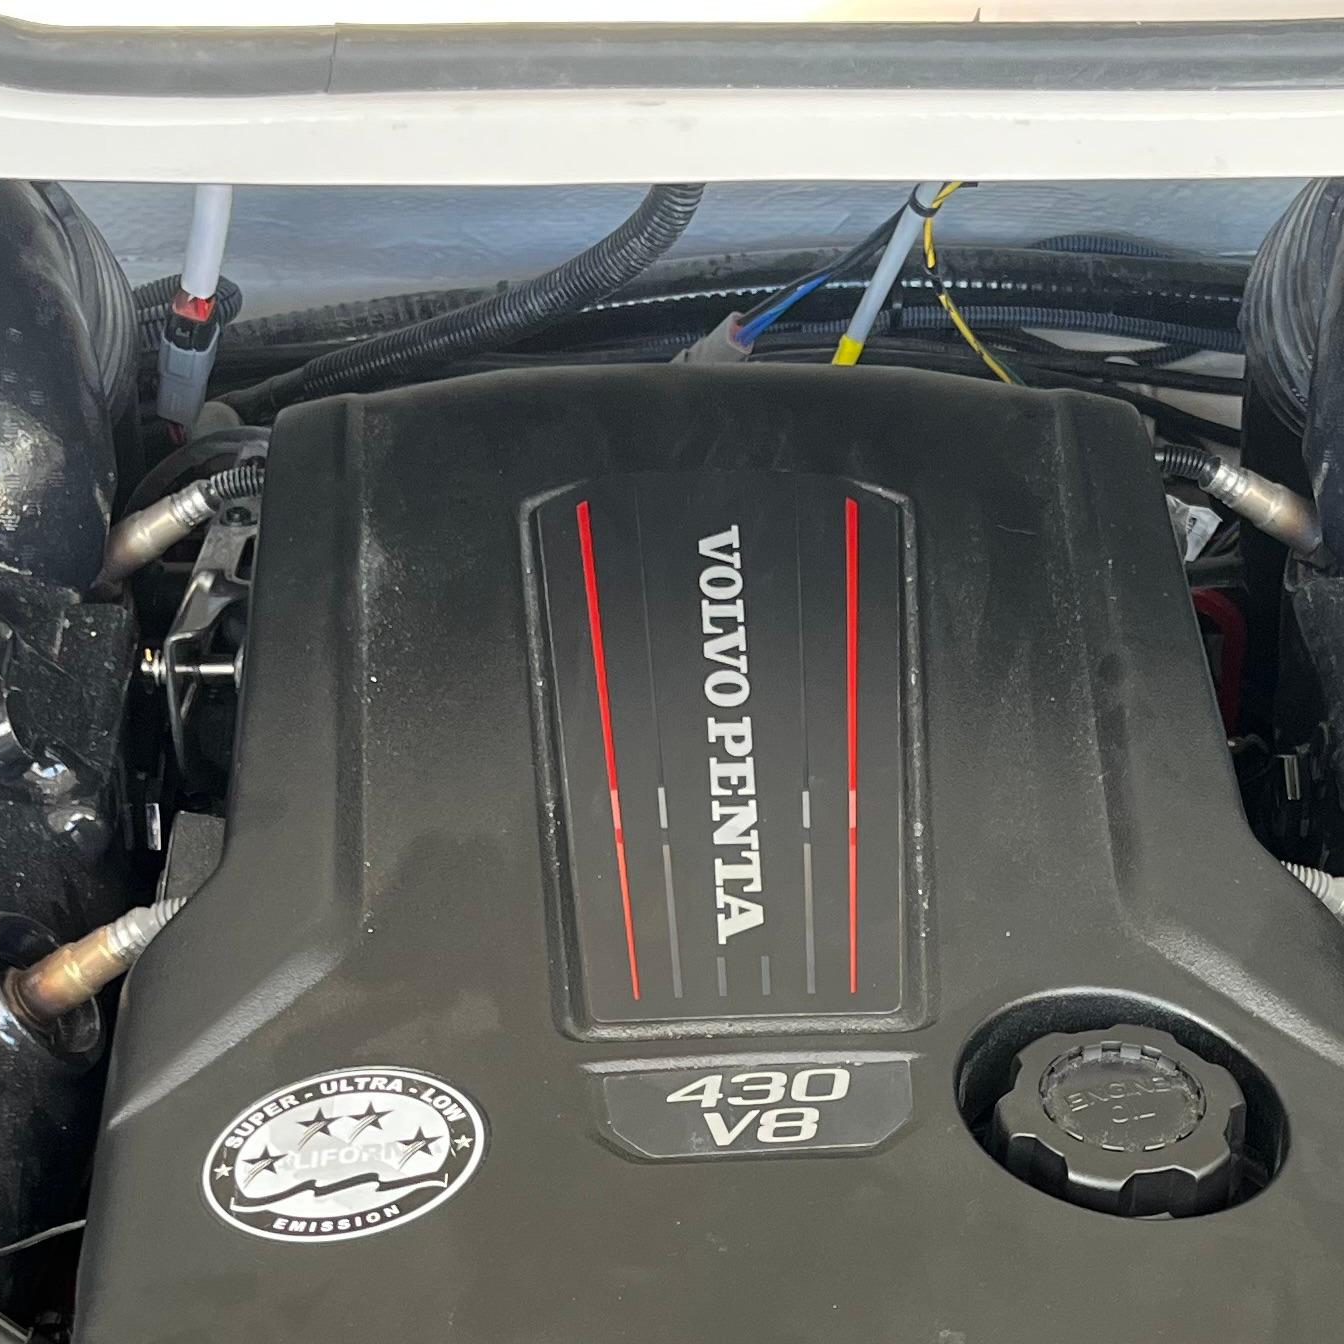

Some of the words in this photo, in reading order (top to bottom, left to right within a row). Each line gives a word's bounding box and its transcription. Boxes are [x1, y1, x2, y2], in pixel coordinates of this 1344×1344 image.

[698, 525, 750, 707] VOLVO
[707, 717, 764, 945] PENTA
[225, 1095, 301, 1150] SUPER
[320, 1077, 404, 1096] ULTRA
[420, 1087, 468, 1123] LOW
[666, 1068, 851, 1108] 430
[703, 1107, 820, 1147] V8
[272, 1205, 401, 1234] EMISSION
